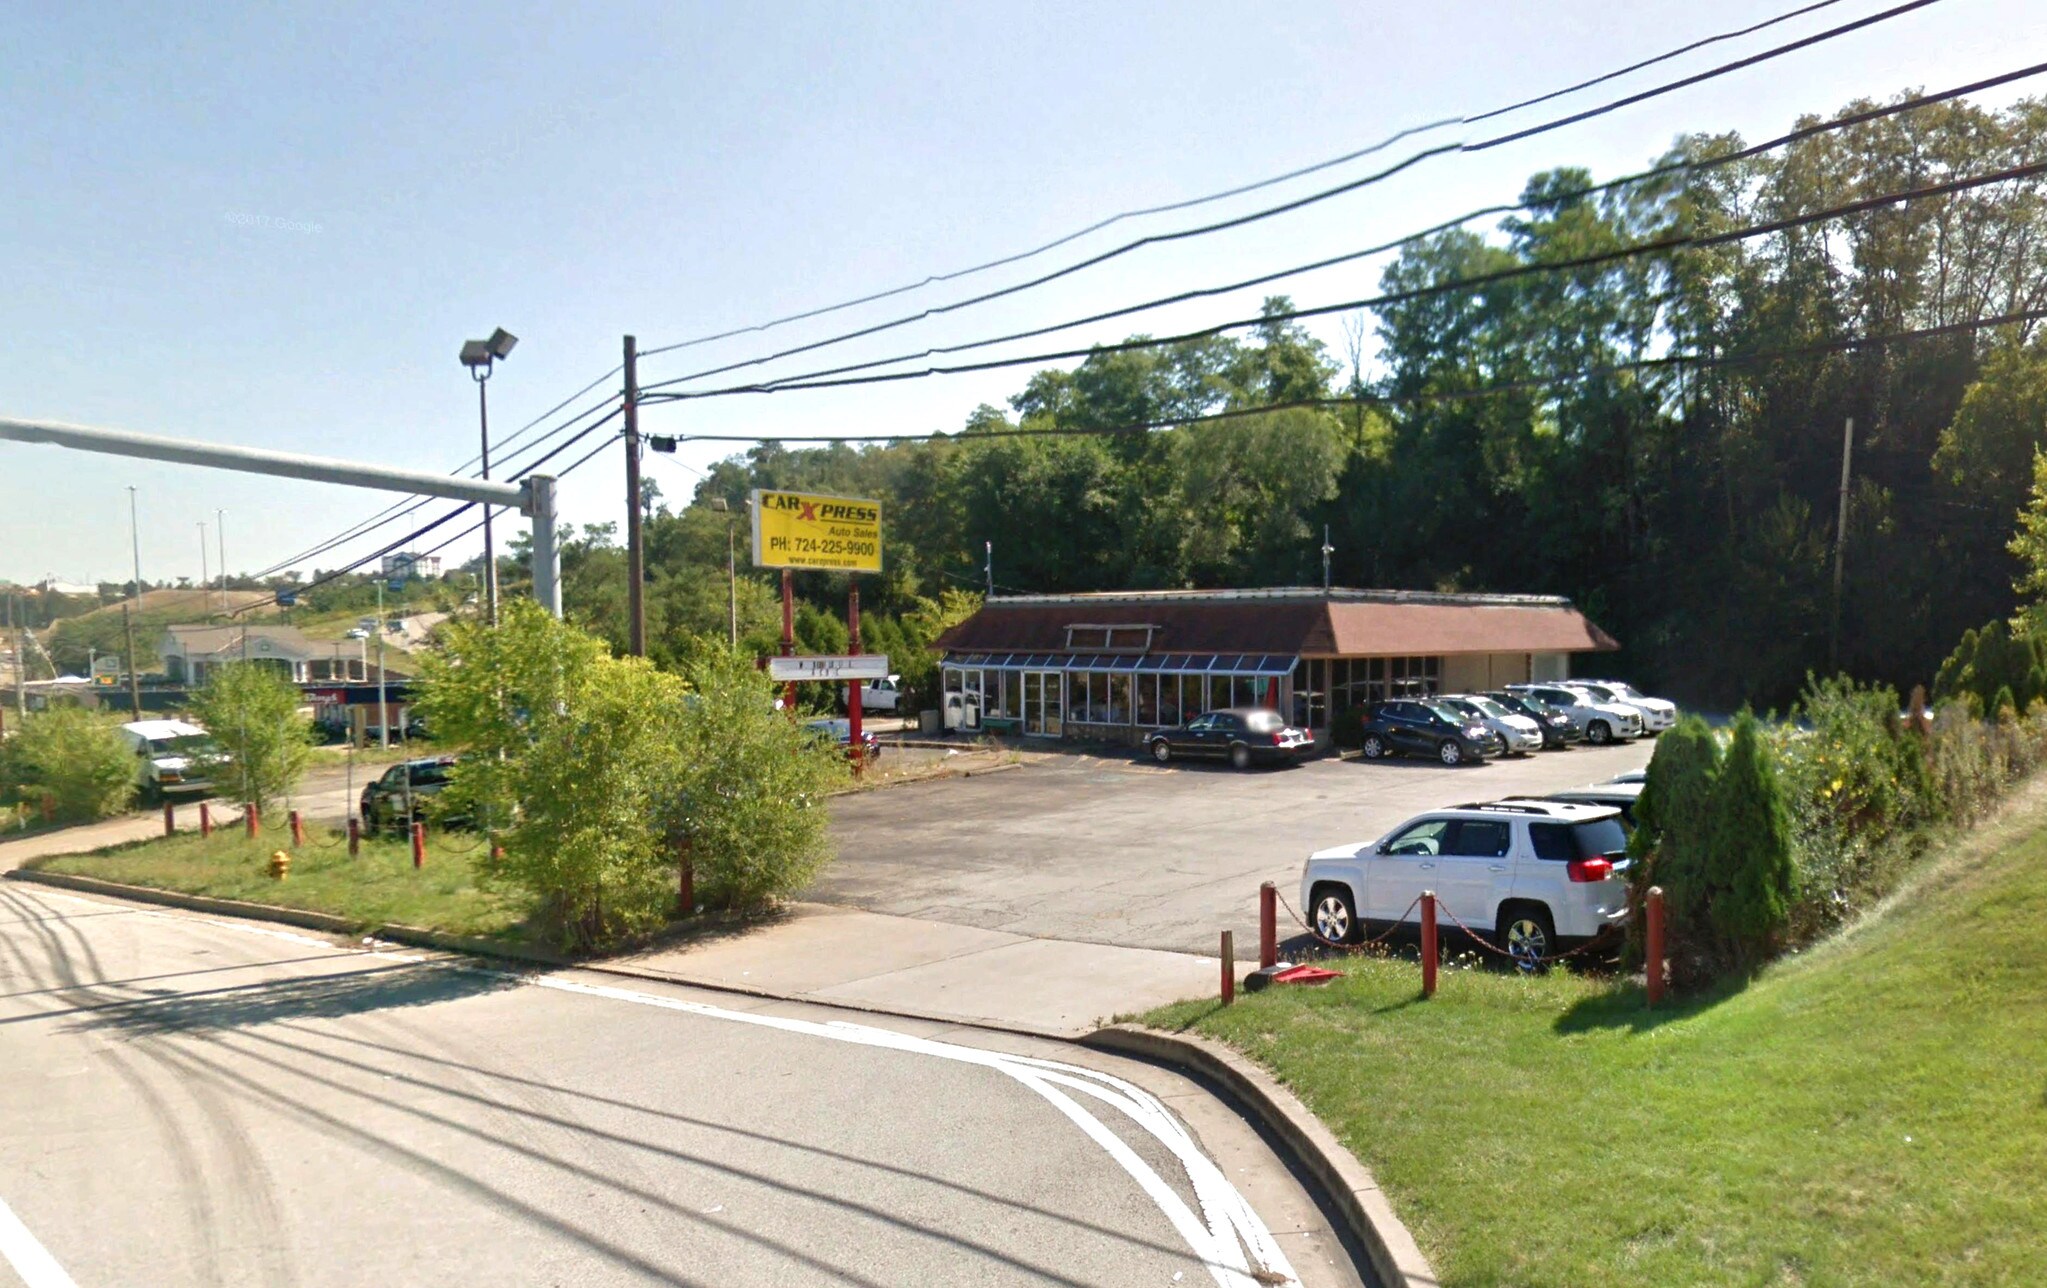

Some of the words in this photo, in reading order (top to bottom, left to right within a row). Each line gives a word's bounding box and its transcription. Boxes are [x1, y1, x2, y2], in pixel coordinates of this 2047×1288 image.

[828, 526, 851, 537] Auto
[853, 528, 878, 539] Sales
[770, 536, 792, 552] PH:
[795, 538, 874, 556] 724-225-9900
